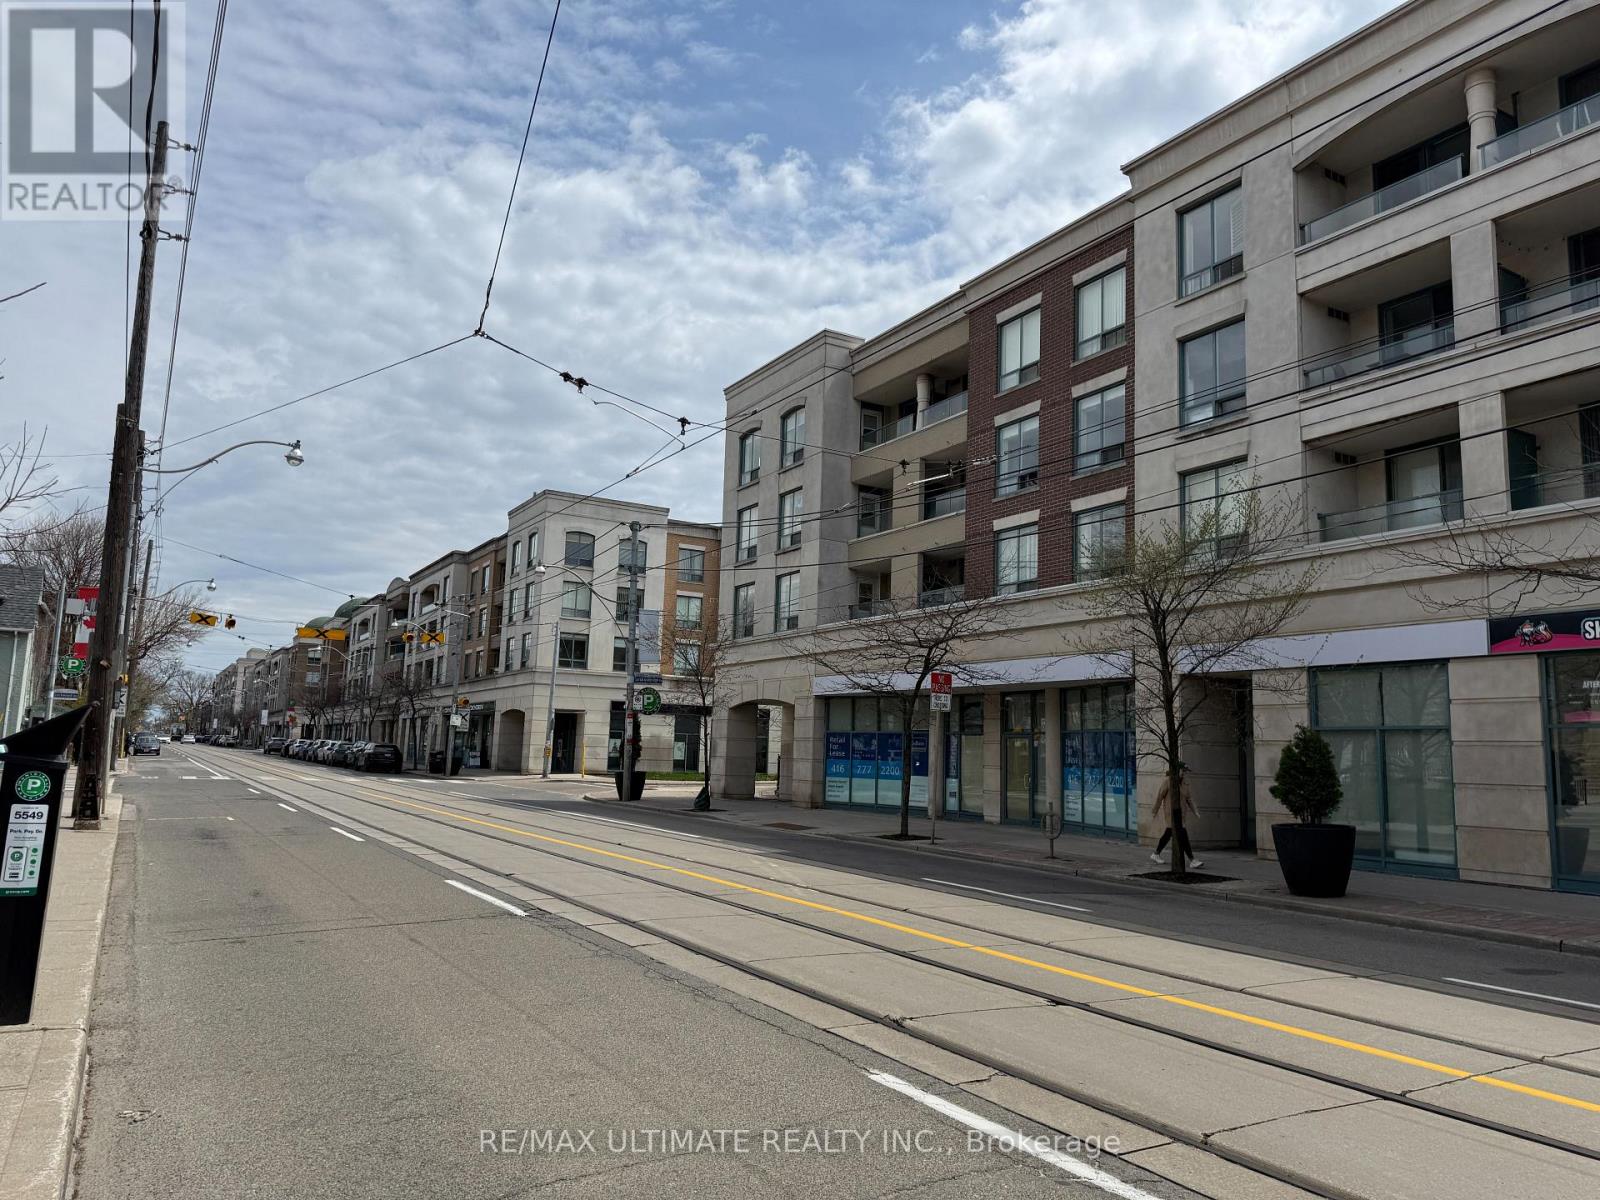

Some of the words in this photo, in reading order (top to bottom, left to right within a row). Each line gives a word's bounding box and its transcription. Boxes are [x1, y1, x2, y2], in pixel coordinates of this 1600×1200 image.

[831, 764, 845, 773] 416
[856, 765, 872, 774] 777
[880, 766, 900, 775] 2200
[27, 778, 42, 790] P
[14, 811, 44, 820] 5549
